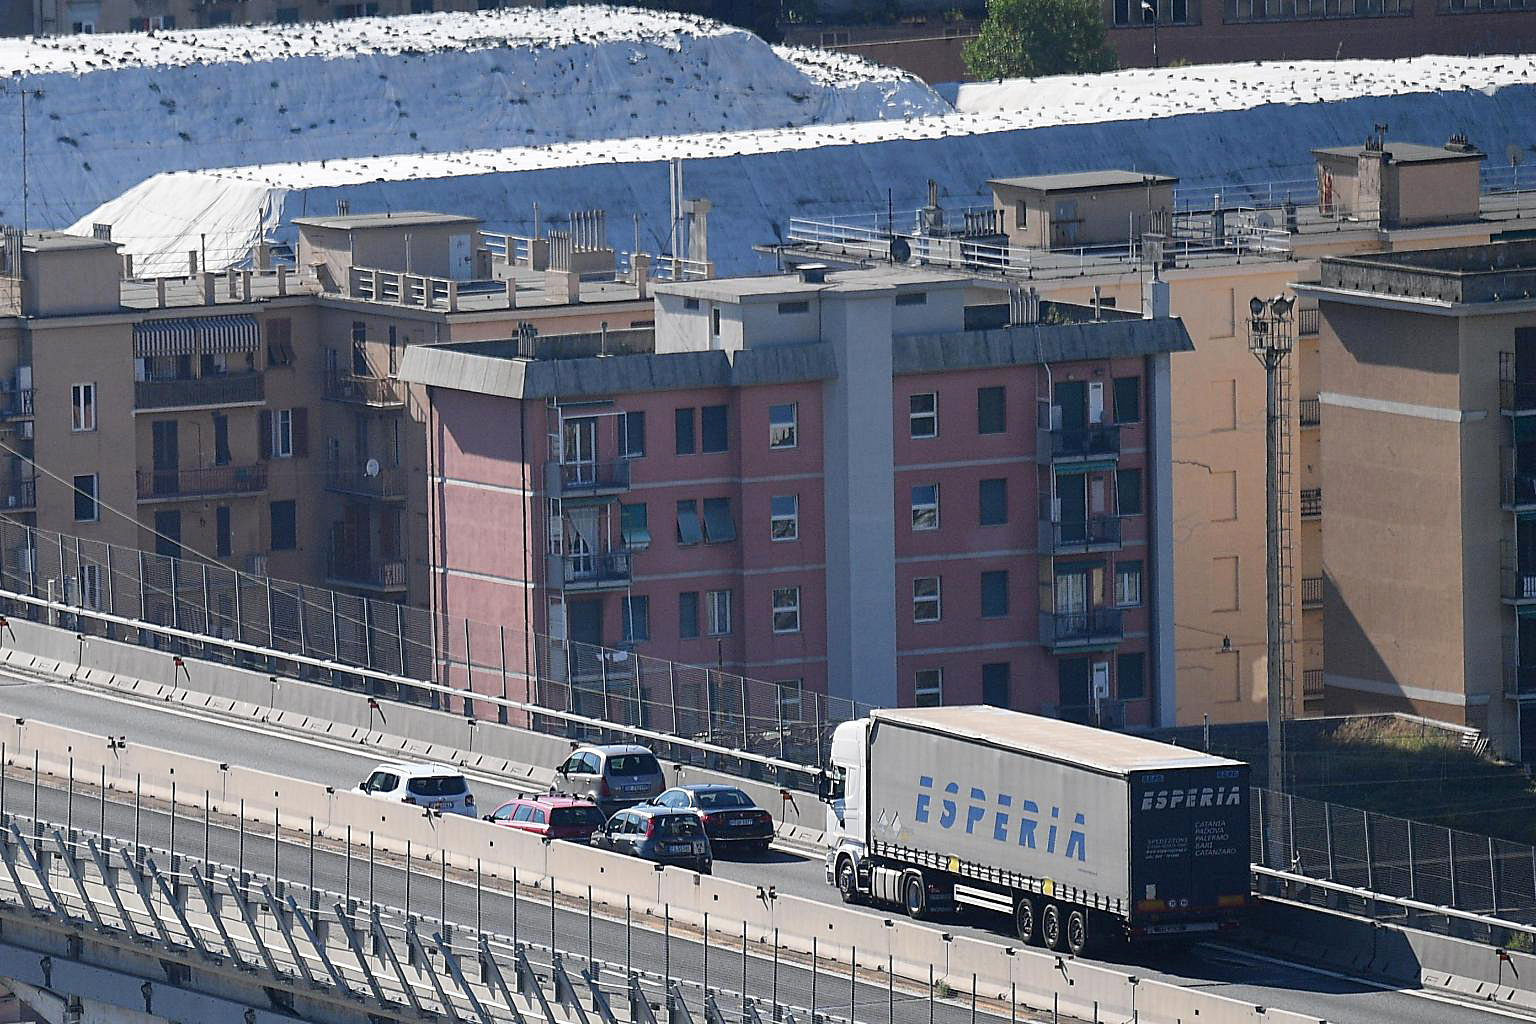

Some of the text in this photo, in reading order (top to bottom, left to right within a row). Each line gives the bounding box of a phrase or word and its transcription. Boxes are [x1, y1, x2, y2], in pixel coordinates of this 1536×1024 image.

[1141, 786, 1240, 811] ESPERIA
[915, 776, 1086, 862] ESPERIA
[1195, 819, 1226, 829] CATANIA
[1195, 827, 1224, 835] PADOVA
[1195, 834, 1229, 842] PALERMO
[1195, 841, 1213, 849] BARI
[1195, 848, 1237, 857] CATANZARO
